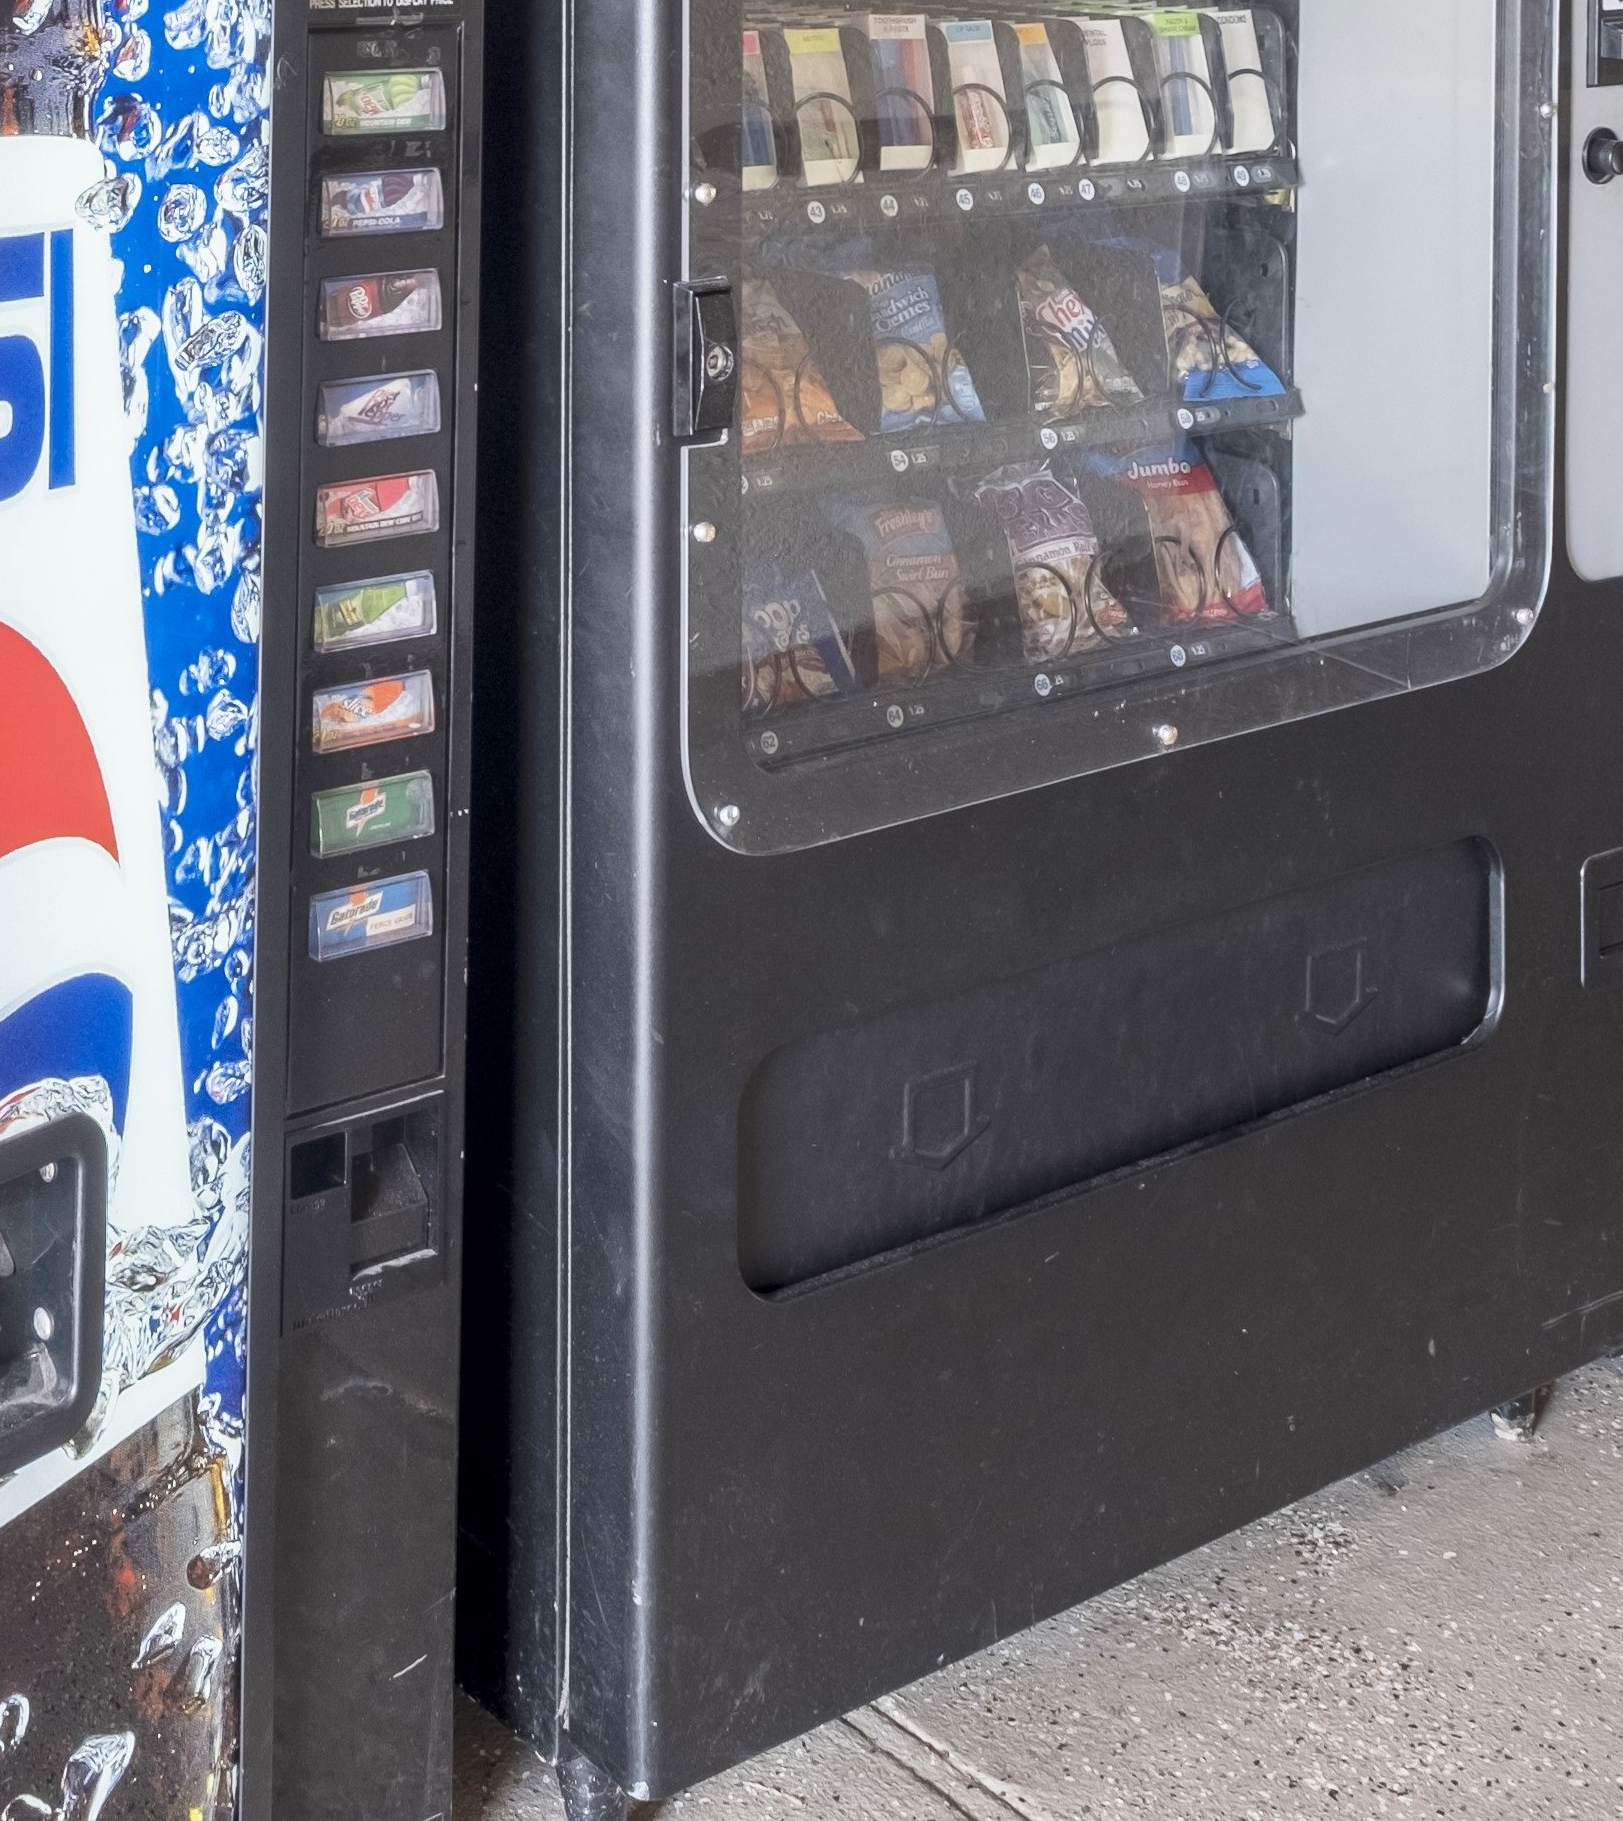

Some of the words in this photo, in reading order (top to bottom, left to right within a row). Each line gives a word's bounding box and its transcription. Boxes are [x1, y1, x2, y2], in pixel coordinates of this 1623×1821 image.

[1177, 176, 1188, 188] 48
[1031, 187, 1042, 200] 46
[1081, 183, 1092, 195] 47
[883, 200, 895, 212] 44
[959, 194, 972, 206] 45
[810, 206, 822, 218] 43
[1044, 433, 1056, 445] 56
[894, 454, 906, 467] 54
[1127, 457, 1191, 479] Jumbo
[1147, 481, 1171, 489] Honey
[1173, 479, 1189, 487] Bun
[886, 554, 941, 567] Cinnamon
[896, 568, 922, 581] Swirl
[926, 567, 949, 579] Bun
[1036, 679, 1048, 691] 66
[889, 709, 902, 722] 64
[762, 735, 776, 749] 62
[330, 899, 379, 926] Gatorade
